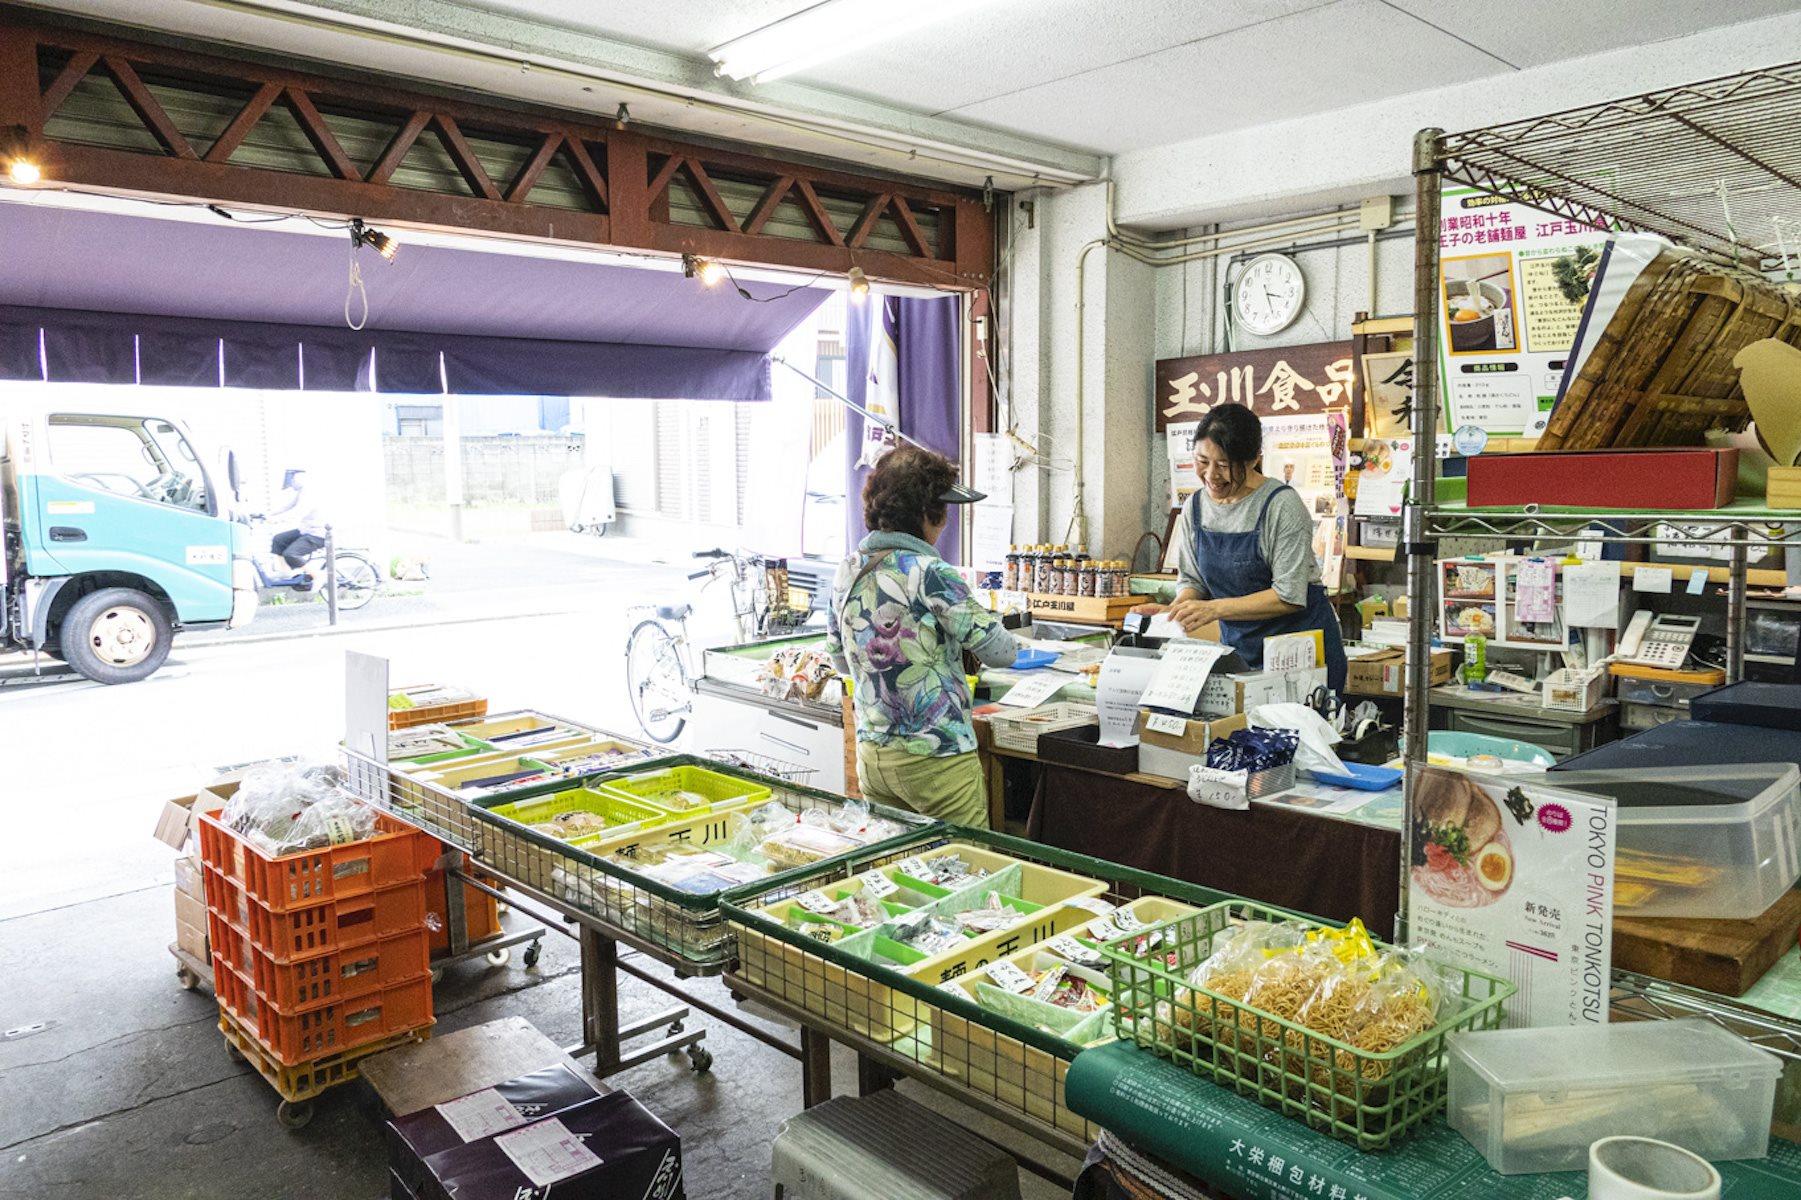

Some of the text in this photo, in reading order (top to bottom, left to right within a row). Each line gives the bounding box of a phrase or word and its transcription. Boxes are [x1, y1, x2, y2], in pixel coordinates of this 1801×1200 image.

[1163, 359, 1353, 418] 玉川食品
[1525, 900, 1561, 921] 新発売
[1582, 806, 1608, 1024] TOKYO PINK TONKOTSU
